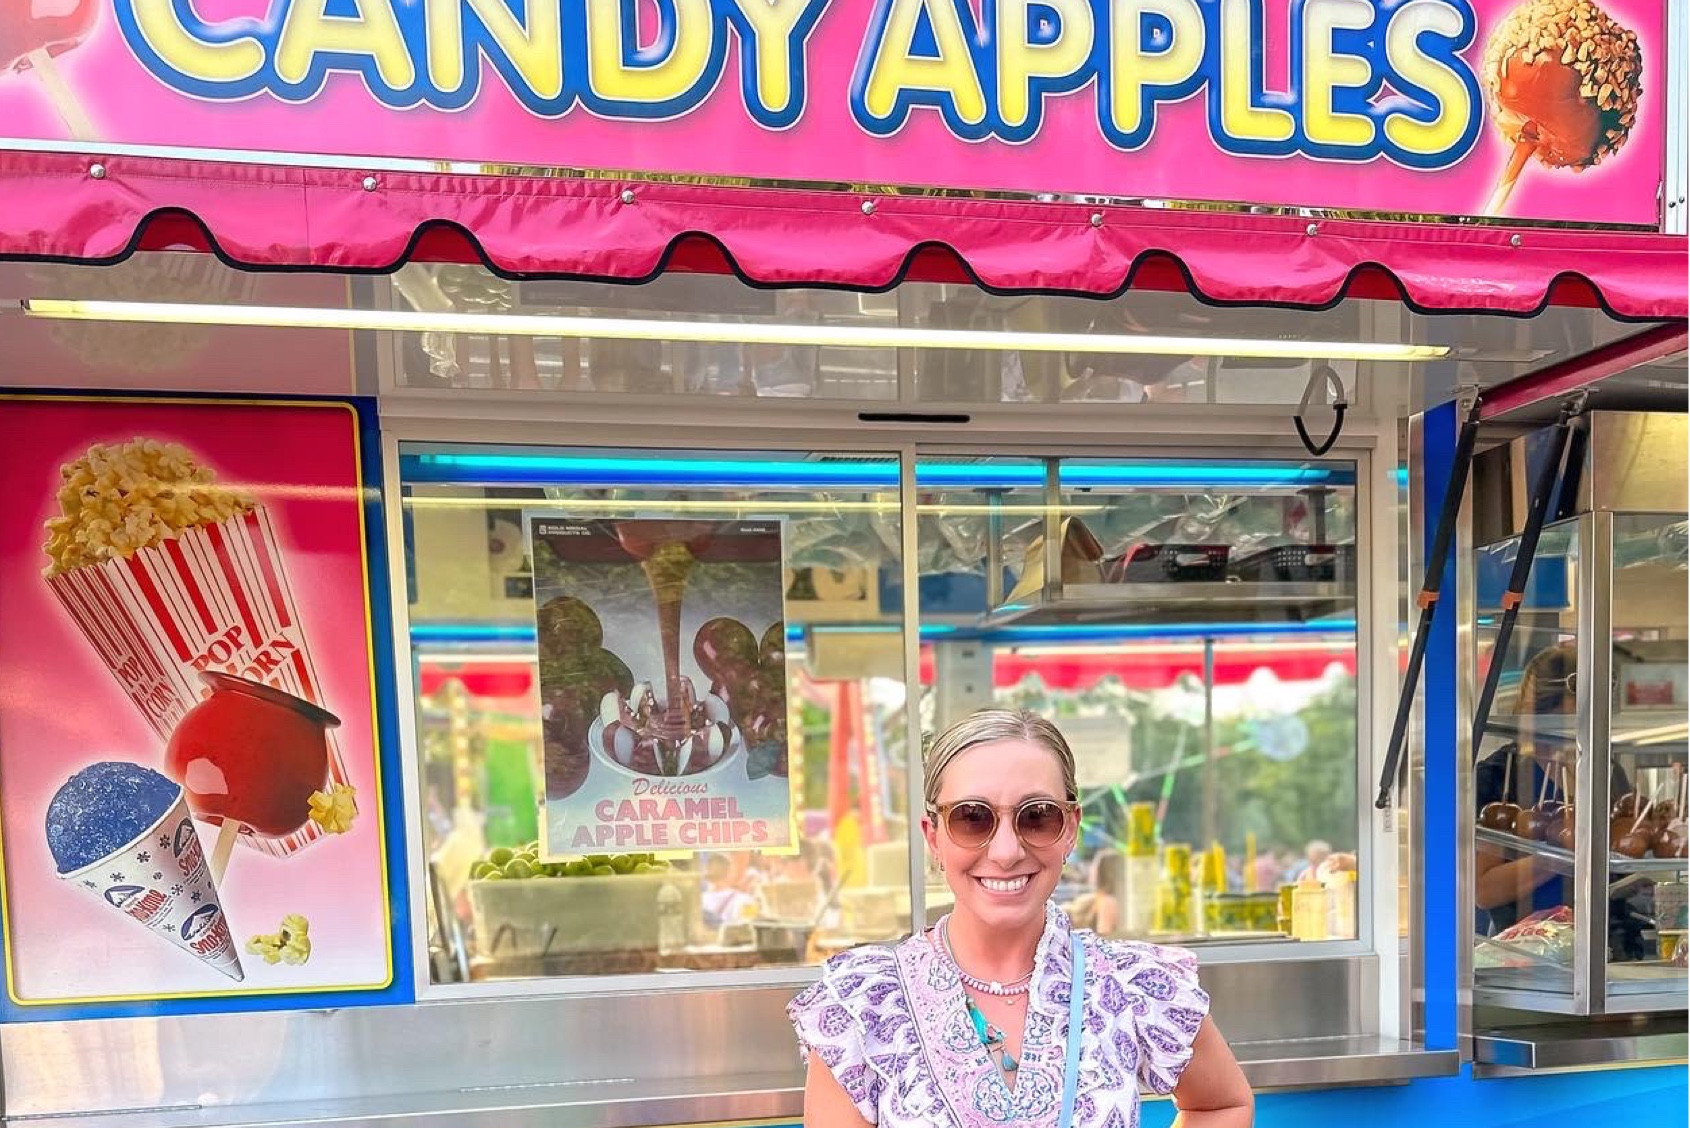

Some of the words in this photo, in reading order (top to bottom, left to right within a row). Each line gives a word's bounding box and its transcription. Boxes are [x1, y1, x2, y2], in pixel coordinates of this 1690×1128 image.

[119, 0, 832, 128] CANDY
[853, 0, 1484, 168] APPLES
[190, 625, 245, 671] POP
[117, 655, 143, 689] POP
[145, 681, 176, 718] CORN
[632, 777, 708, 796] Delicious
[595, 797, 744, 822] CARAMEL
[571, 822, 669, 848] APPLE
[678, 820, 769, 845] CHIPS
